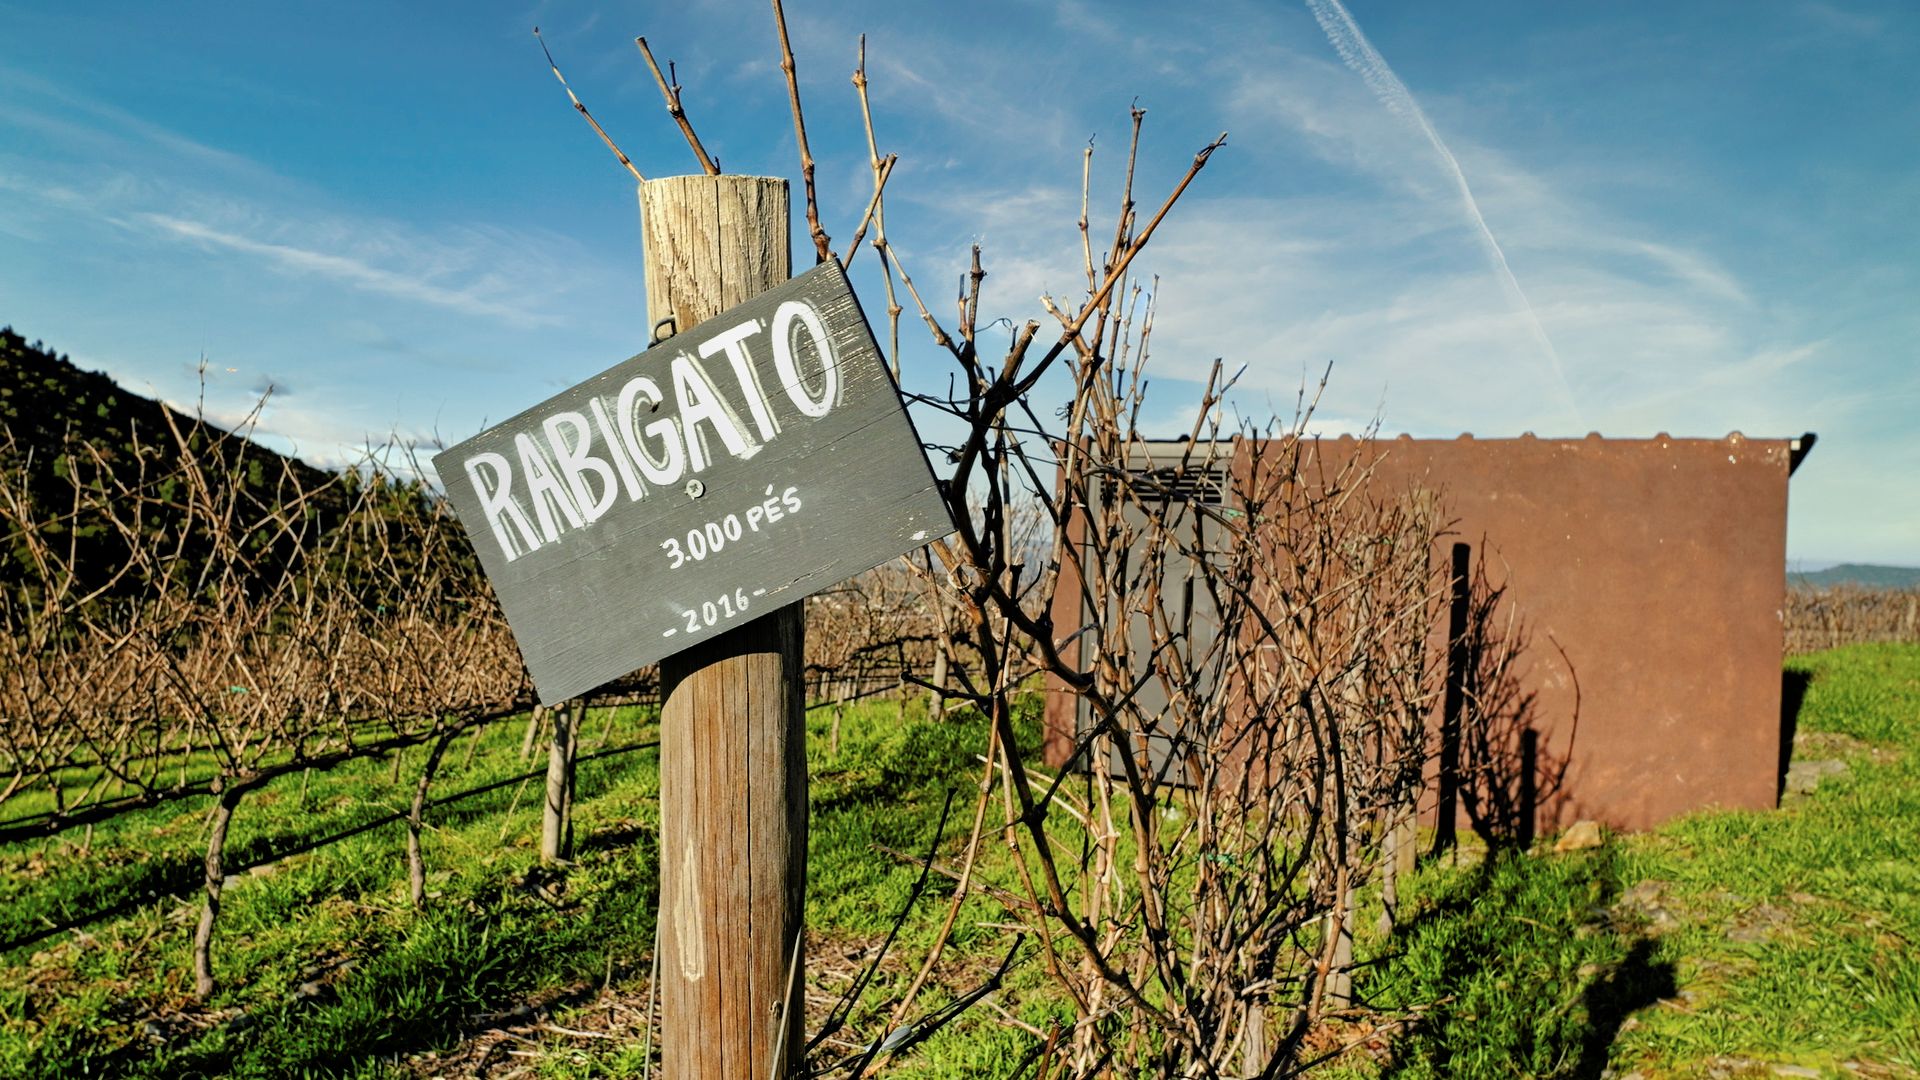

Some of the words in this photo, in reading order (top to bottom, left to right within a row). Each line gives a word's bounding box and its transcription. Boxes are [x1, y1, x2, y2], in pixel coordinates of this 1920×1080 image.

[464, 299, 841, 563] RABIGATO
[661, 514, 743, 570] 3.000
[746, 484, 802, 532] PÉS
